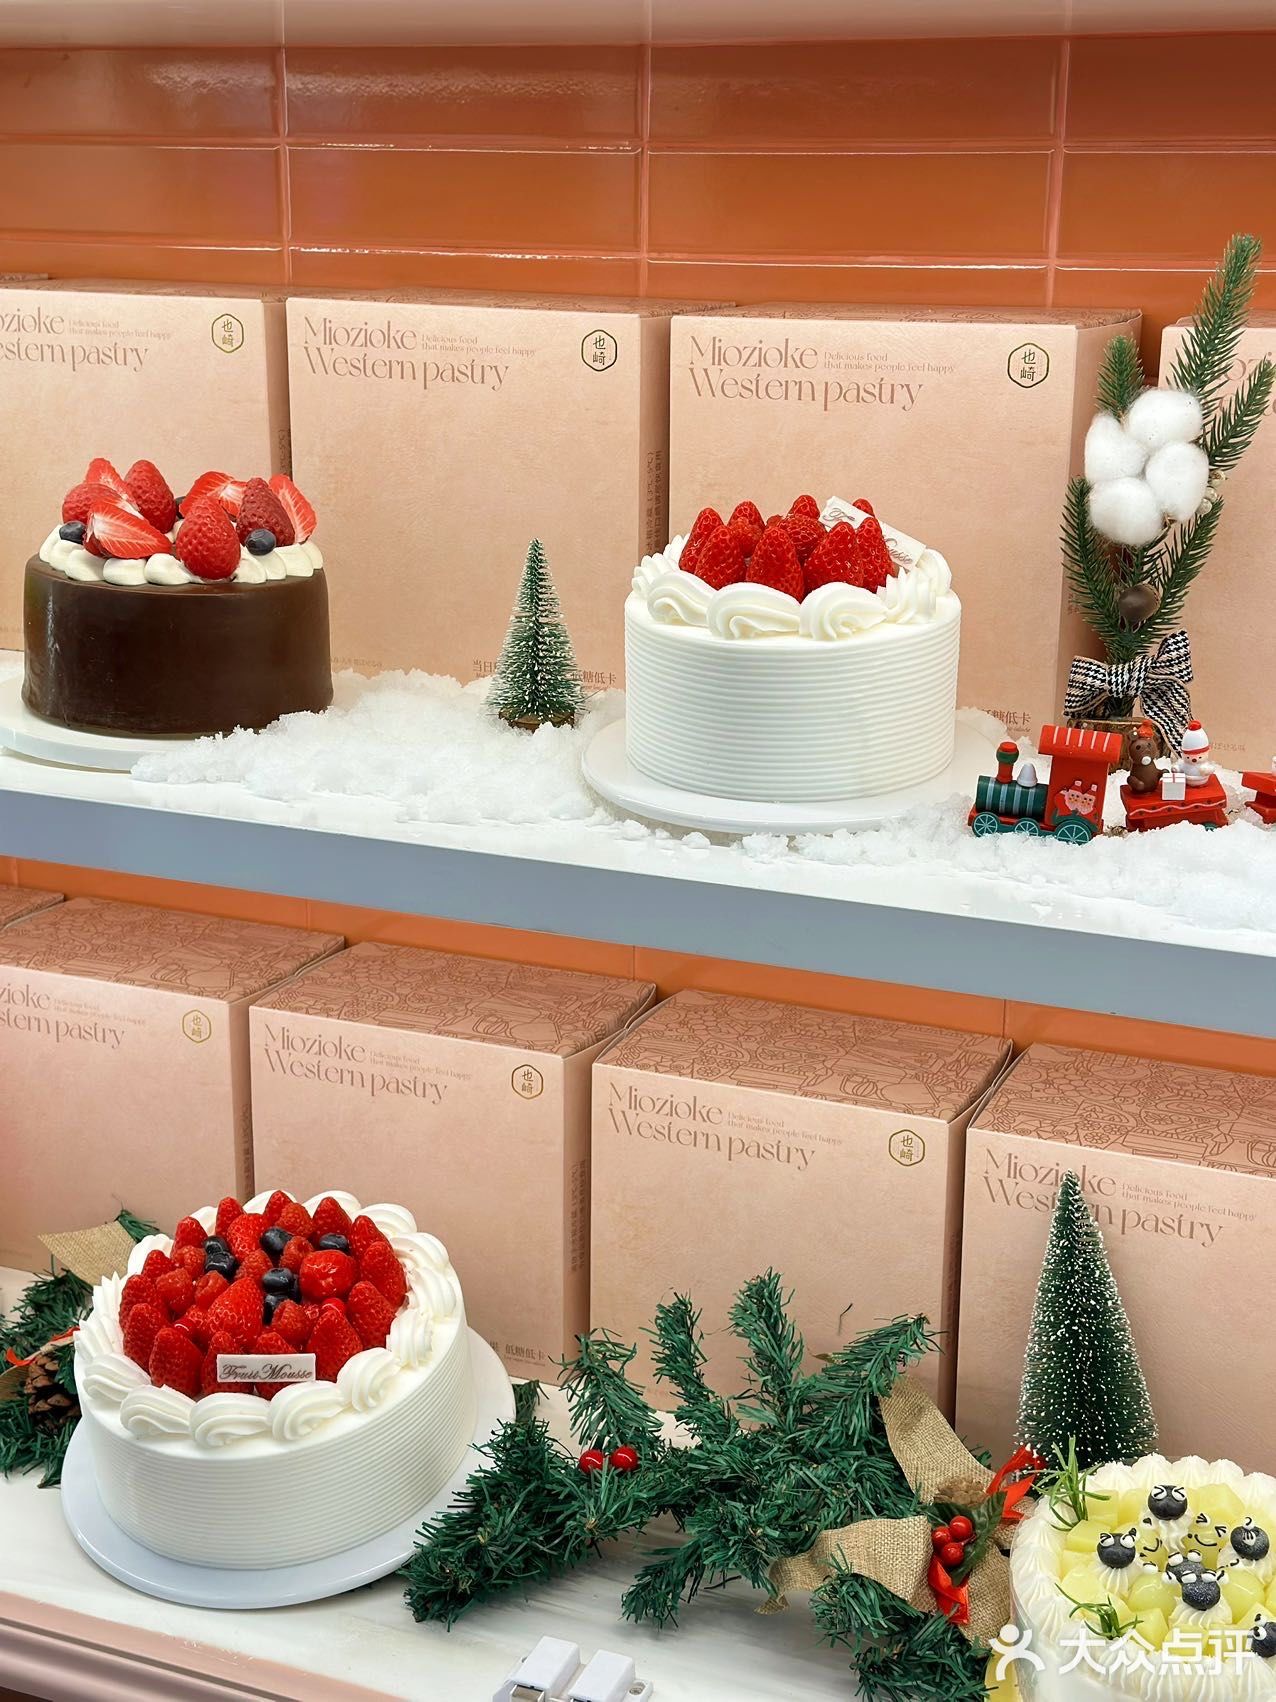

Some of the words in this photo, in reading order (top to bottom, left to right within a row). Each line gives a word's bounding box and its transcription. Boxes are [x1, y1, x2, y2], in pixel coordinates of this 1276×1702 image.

[303, 316, 418, 351] Miozioke
[421, 334, 457, 343] Delicious
[459, 335, 478, 344] food
[422, 342, 438, 350] that
[440, 343, 464, 352] makes
[466, 345, 493, 354] people
[512, 346, 536, 357] happy
[592, 334, 607, 366] 也崎
[71, 341, 148, 372] pastry
[303, 345, 417, 381] Western
[422, 355, 510, 391] pastry
[689, 335, 818, 369] Miozioke
[824, 351, 865, 361] Delicious
[866, 352, 888, 361] food
[824, 360, 842, 369] that
[844, 361, 872, 370] makes
[874, 362, 905, 373] people
[908, 362, 925, 372] feel
[927, 363, 954, 375] happy
[1020, 348, 1037, 382] 也崎
[688, 367, 817, 402] Western
[823, 376, 923, 412] pastry
[55, 1020, 125, 1049] pastry
[264, 1023, 367, 1063] Miozioke
[264, 1047, 366, 1089] Western
[370, 1071, 448, 1105] pastry
[608, 1081, 723, 1126] Miozioke
[608, 1106, 722, 1152] Western
[727, 1135, 816, 1171] pastry
[1122, 1183, 1163, 1197] Delicious
[1165, 1191, 1188, 1201] food
[1122, 1191, 1140, 1201] that
[1142, 1195, 1172, 1205] makes
[1173, 1200, 1206, 1212] people
[1227, 1208, 1256, 1221] happy
[1120, 1207, 1224, 1248] pastry
[260, 1363, 313, 1380] Mousse
